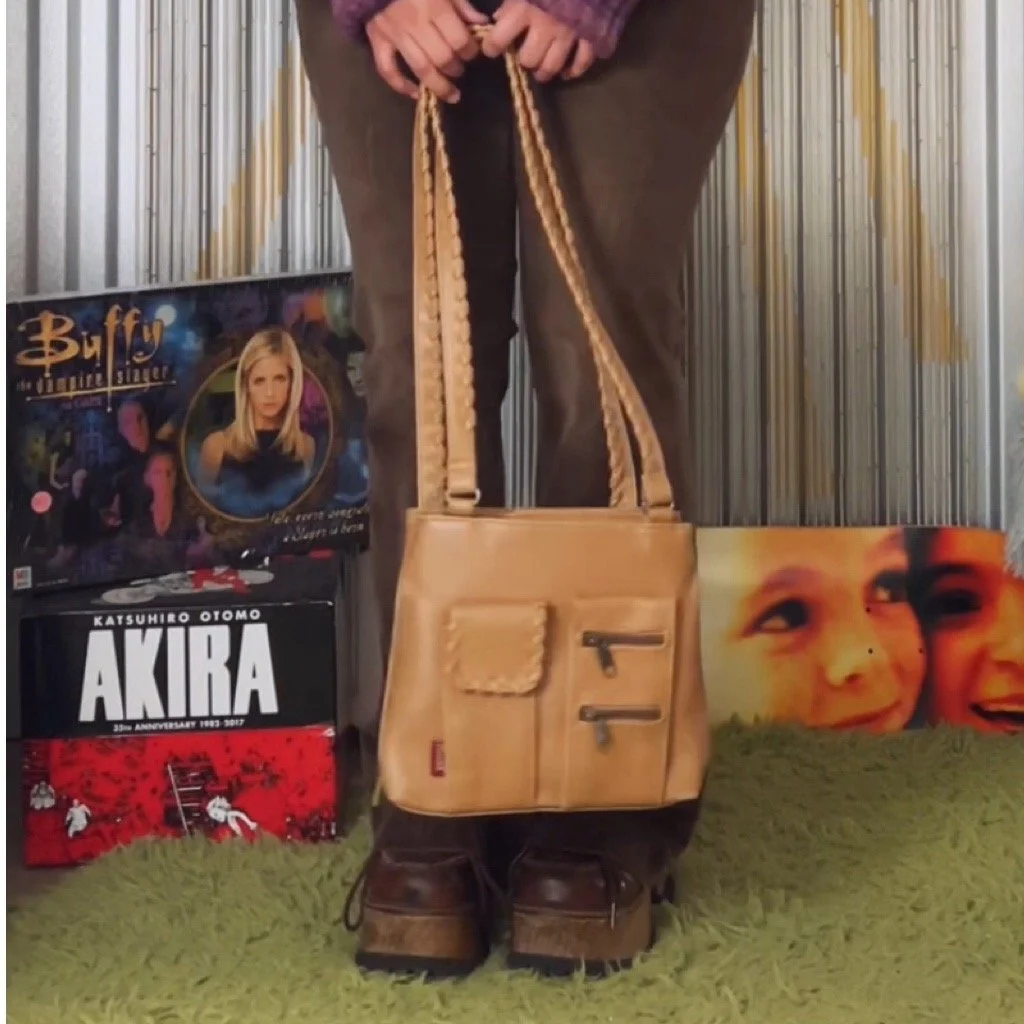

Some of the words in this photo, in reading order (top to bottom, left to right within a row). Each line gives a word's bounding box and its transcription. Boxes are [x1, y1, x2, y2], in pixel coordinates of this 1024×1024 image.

[16, 304, 165, 413] Buffy
[93, 611, 190, 627] KATSUHIRO
[200, 609, 261, 623] OTOMO
[79, 623, 279, 722] AKIRA
[135, 720, 197, 731] ANNIVERSARY
